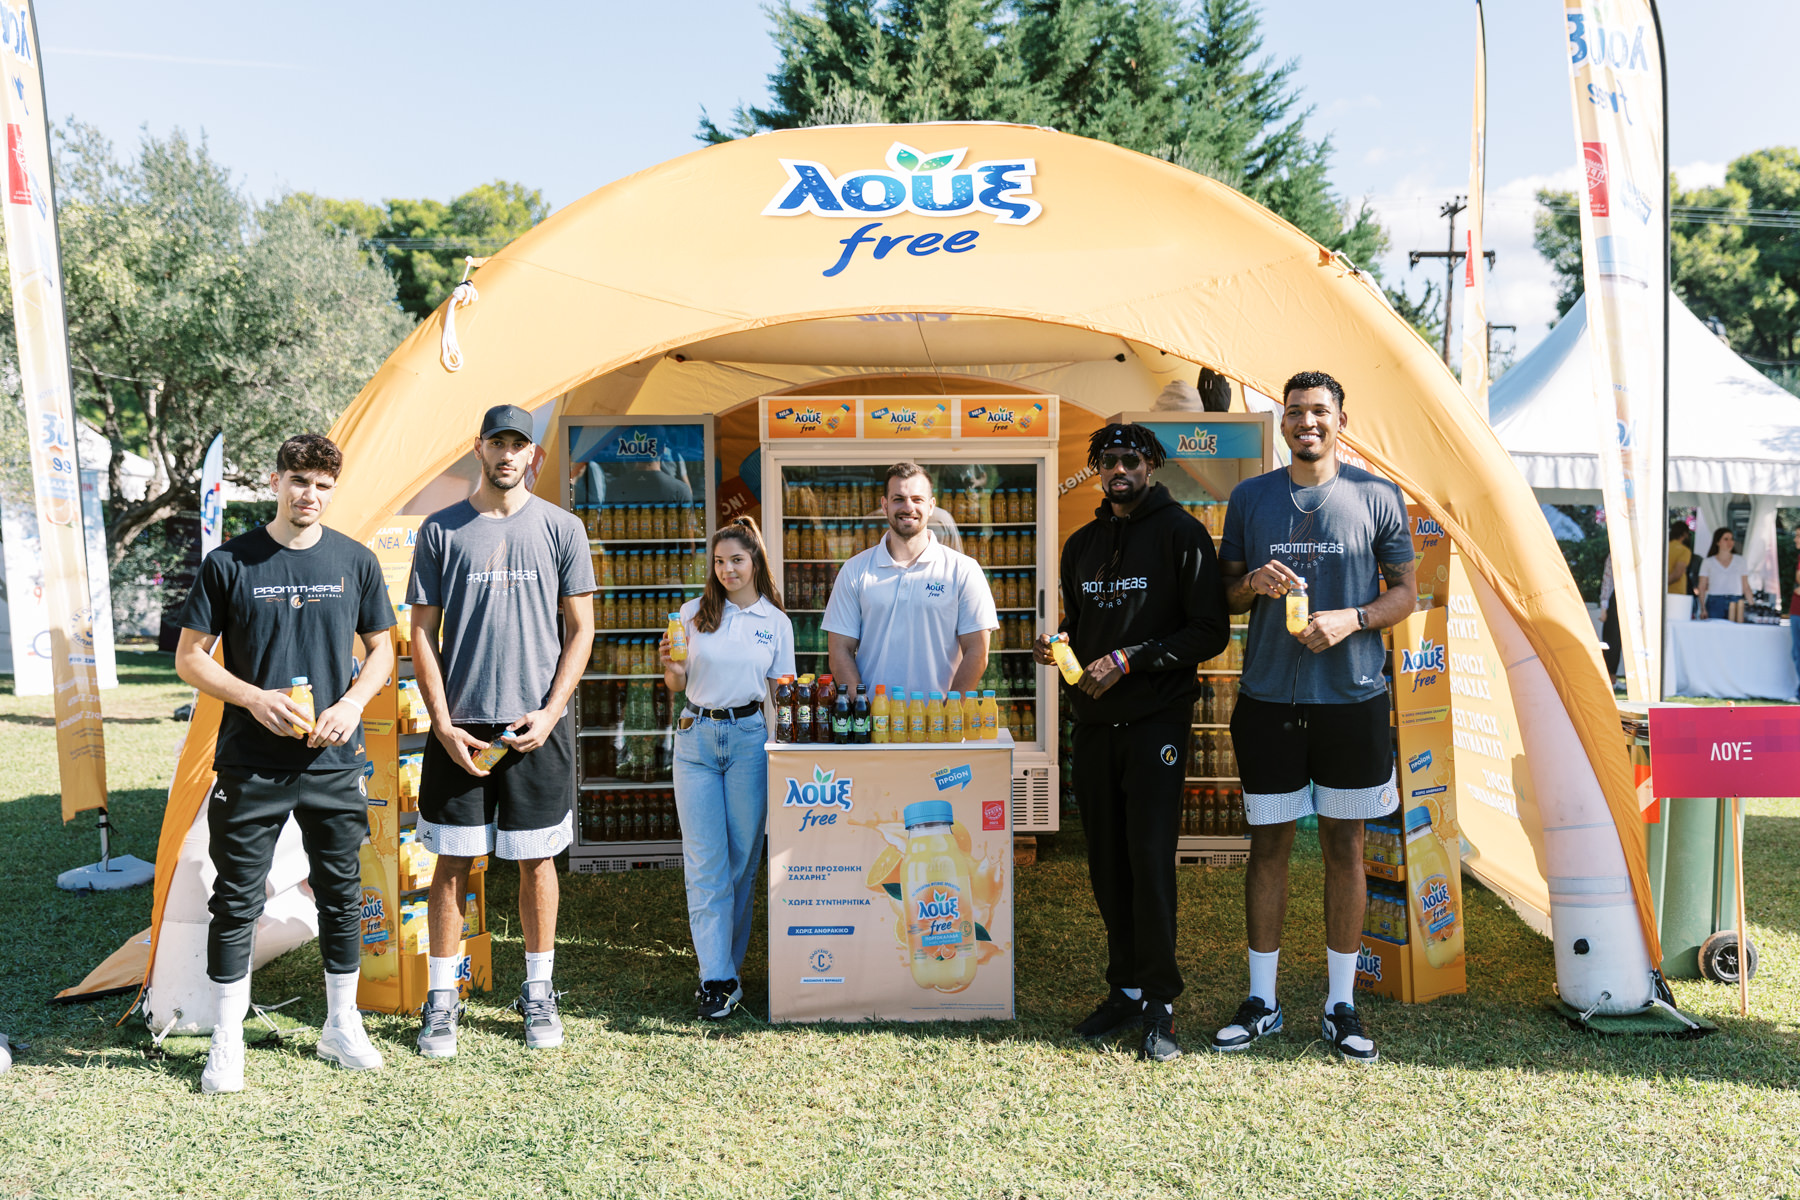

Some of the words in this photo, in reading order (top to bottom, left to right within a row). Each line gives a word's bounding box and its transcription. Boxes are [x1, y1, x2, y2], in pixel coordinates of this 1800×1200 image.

[776, 163, 1031, 220] λουξ
[822, 222, 980, 277] free
[794, 410, 823, 426] λουξ
[889, 410, 918, 426] λουξ
[986, 409, 1015, 425] λουξ
[799, 424, 816, 433] free
[895, 424, 912, 433] free
[991, 422, 1009, 432] free
[618, 438, 658, 457] λουξ
[1178, 434, 1218, 454] λουξ
[378, 536, 400, 549] ΝΕΑ
[1421, 536, 1438, 551] free
[925, 582, 945, 594] λουξ
[754, 629, 774, 643] λουξ
[1402, 646, 1446, 672] λουξ
[1412, 673, 1437, 692] free
[1710, 741, 1753, 761] ΛΟΥΞ
[935, 768, 949, 776] ΝΕΟ
[785, 778, 853, 811] λουξ
[798, 809, 838, 831] free
[788, 865, 813, 873] ΧΩΡΙΣ
[815, 865, 862, 873] ΠΡΟΣΘΗΚΗ
[1420, 883, 1450, 912] λουξ
[918, 897, 959, 919] λουξ
[1432, 905, 1447, 923] free
[367, 920, 381, 935] free
[928, 919, 952, 936] free
[455, 956, 471, 980] υξ
[1356, 954, 1382, 982] ουξ
